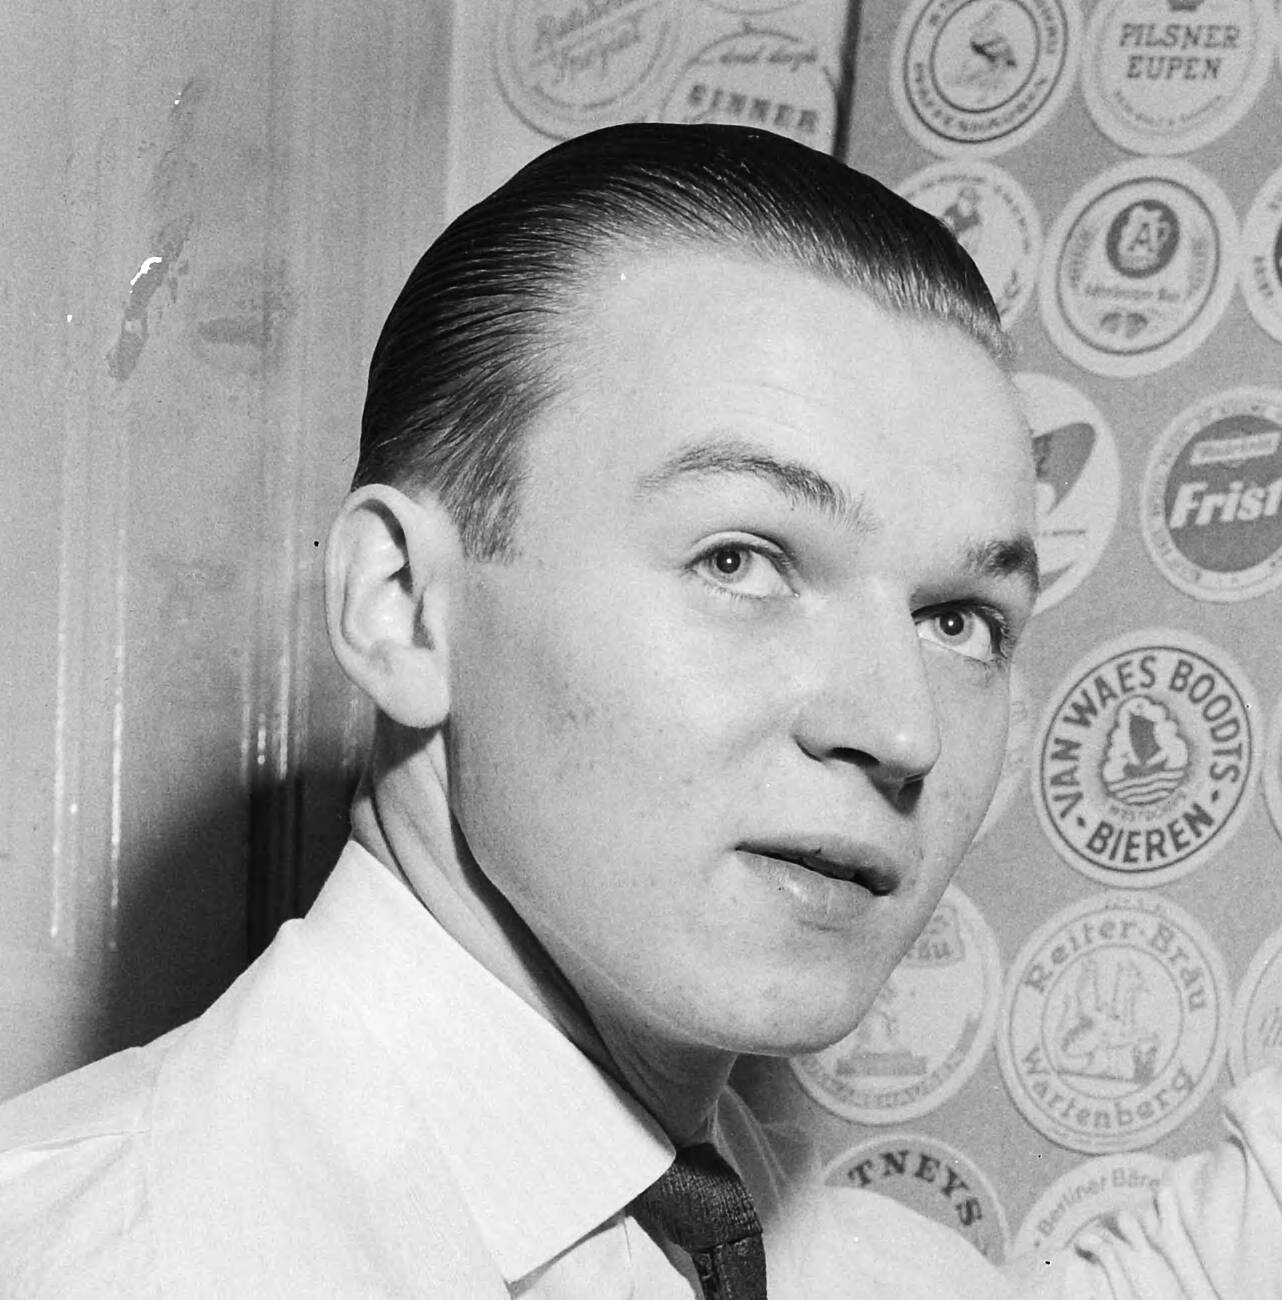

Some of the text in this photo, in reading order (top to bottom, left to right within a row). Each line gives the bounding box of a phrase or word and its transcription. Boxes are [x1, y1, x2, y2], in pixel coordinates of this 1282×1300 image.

[1119, 23, 1241, 50] PILSNER
[1126, 55, 1224, 80] EUPEN
[1062, 654, 1158, 728] WAES
[1168, 659, 1243, 784] BOODTS
[1050, 737, 1084, 819] VAN
[1085, 802, 1215, 863] BIEREN
